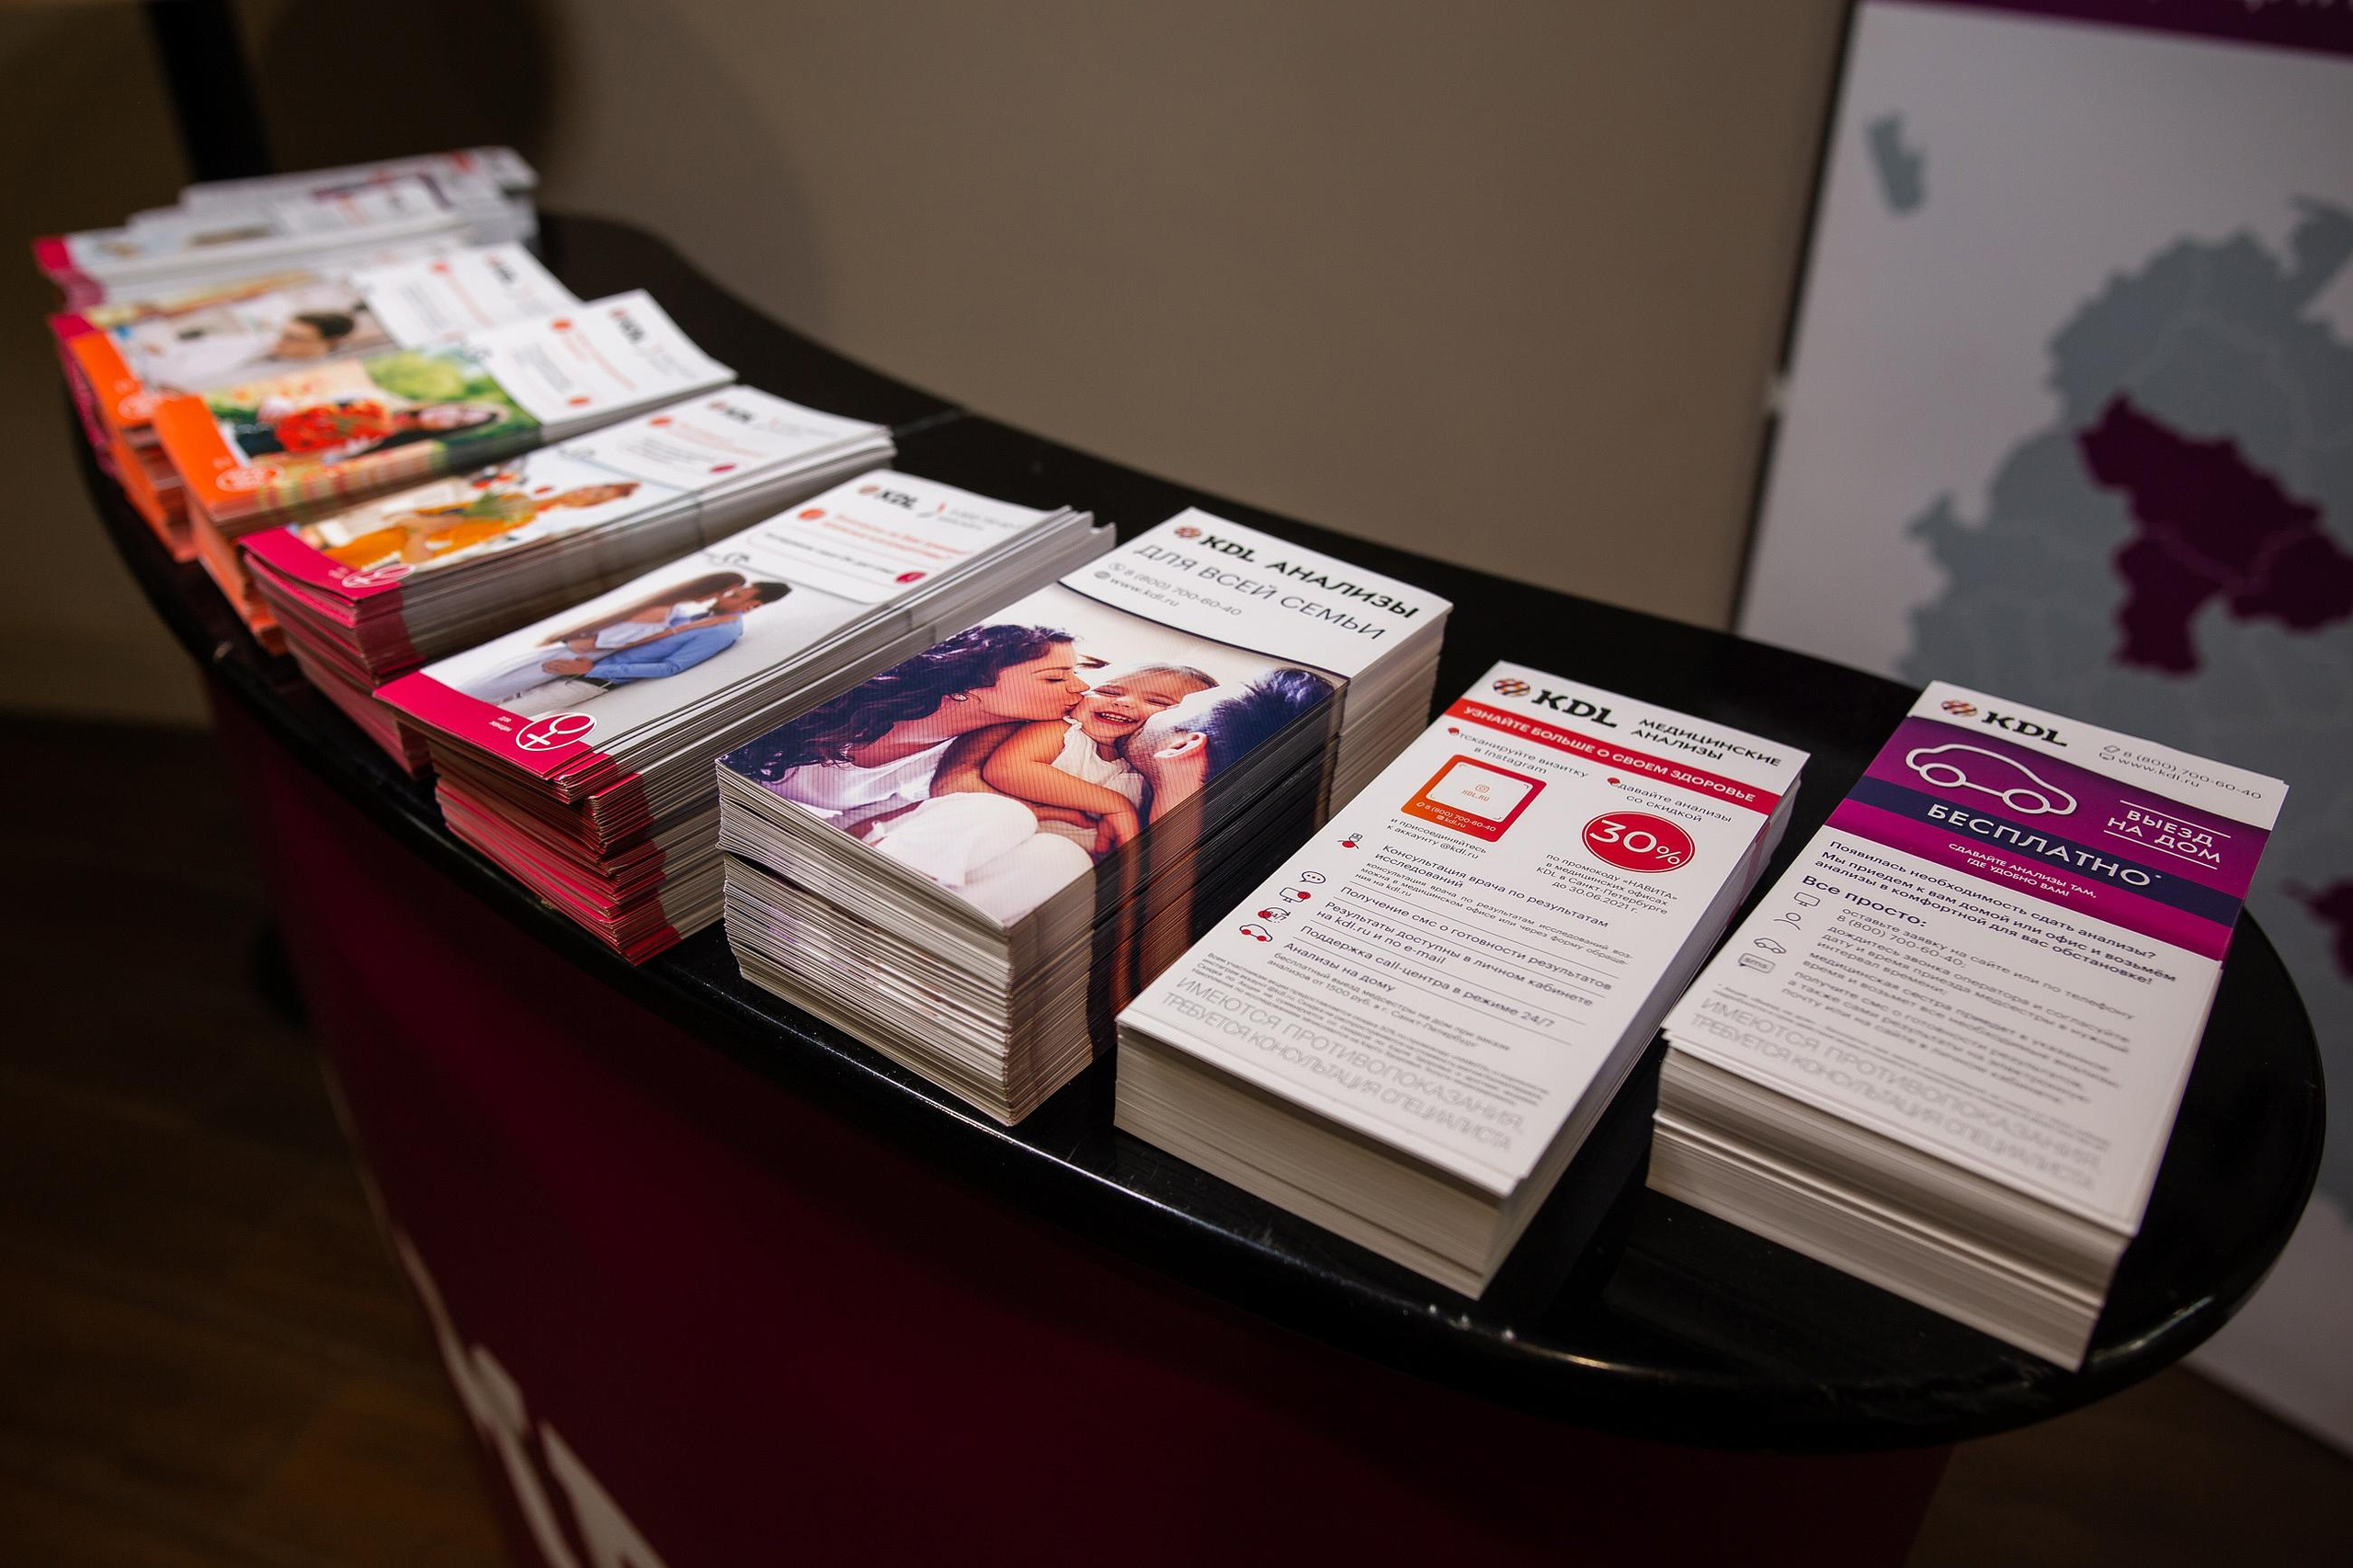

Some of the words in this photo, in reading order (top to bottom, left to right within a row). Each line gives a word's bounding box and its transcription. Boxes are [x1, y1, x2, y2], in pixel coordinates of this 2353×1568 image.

[1109, 578, 1180, 608] www.kdl.ru
[1132, 544, 1199, 572] ДЛЯ
[1197, 566, 1278, 600] ВСЕЙ
[1279, 596, 1386, 640] СЕМЬИ
[1133, 574, 1172, 591] (800)
[1172, 586, 1243, 616] 700-60-40
[1199, 535, 1255, 562] KDL
[1266, 562, 1419, 619] АНАЛИЗЫ
[1530, 688, 1618, 729] KDL
[1981, 710, 2068, 747] KDL
[1463, 706, 1530, 733] УЗНАЙТЕ
[1530, 727, 1596, 754] БОЛЬШЕ
[1597, 748, 1610, 757] О
[1612, 753, 1668, 775] СВОЕМ
[1670, 770, 1756, 802] ЗДОРОВЬЕ
[1483, 749, 1547, 775] Instagram
[1631, 729, 1723, 760] АНАЛИЗЫ
[1639, 719, 1781, 767] МЕДИЦИНСКИЕ
[1538, 758, 1589, 778] визитку
[2118, 758, 2200, 788] www.kdl.ru
[2136, 755, 2177, 775] (800)
[2182, 768, 2262, 800] 700-60-40
[1461, 790, 1491, 802] KDL.RU
[1626, 795, 1643, 803] со
[1646, 801, 1702, 823] скидкой
[1674, 801, 1732, 823] анализы
[1399, 821, 1486, 854] присоединяйтесь
[1430, 806, 1454, 818] (800)
[1454, 813, 1496, 832] 700-60-40
[1444, 817, 1466, 828] kdl.ru
[2107, 817, 2143, 837] НА
[2154, 834, 2221, 863] ДОМ
[2126, 810, 2213, 848] ВЫЕЗД
[1394, 827, 1439, 846] аккаунту
[1439, 842, 1479, 859] @kdl.ru
[1585, 816, 1692, 869] 30%
[1374, 853, 1463, 889] исследований
[1382, 845, 1467, 879] Консультация
[1468, 876, 1506, 892] врача
[1507, 890, 1525, 899] по
[1526, 896, 1608, 927] результатам
[1536, 866, 1556, 878] KDL
[1568, 877, 1668, 915] Санкт-Петербурге
[1546, 854, 1561, 862] по
[1562, 858, 1621, 882] промокоду
[1622, 880, 1677, 900] «НАВИТА»
[1553, 865, 1626, 892] медицинских
[1627, 889, 1668, 906] офисах
[1949, 843, 2007, 867] СДАВАЙТЕ
[2008, 864, 2067, 887] АНАЛИЗЫ
[2071, 883, 2097, 899] ТАМ,
[1966, 858, 1987, 869] ГДЕ
[1990, 865, 2038, 886] УДОБНО
[2040, 882, 2070, 897] ВАМ!
[1366, 862, 1427, 887] консультация
[1429, 885, 1457, 898] врача
[1475, 902, 1535, 926] результатам
[1400, 882, 1463, 908] медицинском
[1465, 905, 1496, 920] офисе
[1498, 917, 1517, 926] или
[1552, 881, 1567, 890] до
[1568, 886, 1630, 910] 30.06.2021
[1802, 875, 1841, 895] Все
[1845, 892, 1927, 927] просто:
[1821, 851, 1847, 865] Мы
[1848, 862, 1914, 889] приедем
[1927, 891, 1957, 904] вам
[1958, 902, 2010, 924] домой
[2013, 920, 2042, 935] или
[2045, 932, 2087, 950] офис
[2090, 948, 2102, 956] и
[2104, 952, 2177, 982] возьмём
[1829, 841, 1906, 873] Появилась
[1909, 869, 2028, 915] необходимость
[2030, 913, 2075, 932] сдать
[2077, 929, 2156, 960] анализы?
[1316, 911, 1333, 921] на
[1334, 916, 1371, 936] kdl.ru
[1383, 937, 1402, 948] по
[1404, 945, 1447, 964] e-mail
[1340, 886, 1410, 916] Получение
[1411, 915, 1438, 927] смс
[1450, 928, 1527, 960] готовности
[1527, 957, 1612, 991] результатов
[1814, 860, 1877, 886] анализы
[1891, 888, 1987, 926] комфортной
[1988, 923, 2018, 937] для
[2021, 934, 2049, 948] вас
[2052, 946, 2153, 985] обстановке!
[1836, 915, 1847, 923] 8
[1848, 919, 1886, 938] (800)
[1889, 933, 1967, 969] 700-60-40;
[1283, 942, 1340, 970] Анализы
[1341, 967, 1358, 978] на
[1358, 974, 1395, 993] дому
[1324, 901, 1395, 934] Результаты
[1395, 930, 1461, 959] доступны
[1472, 960, 1526, 983] личном
[1527, 980, 1593, 1006] кабинете
[1816, 941, 1881, 969] интервал
[1821, 934, 1854, 949] дату
[1867, 950, 1910, 970] время
[1827, 926, 1901, 957] дождитесь
[1903, 954, 1951, 976] звонка
[1953, 973, 2030, 1006] оператора
[1842, 908, 1901, 933] оставьте
[1903, 930, 1949, 951] заявку
[1949, 949, 1968, 959] на
[1970, 956, 2011, 974] сайте
[2013, 971, 2040, 985] или
[1300, 926, 1373, 960] Поддержка
[1375, 957, 1450, 990] call-центра
[1462, 991, 1519, 1016] режиме
[1520, 1011, 1555, 1027] 24/7
[1325, 983, 1350, 997] 1500
[1162, 991, 1252, 1040] ТРЕБУЕТСЯ
[1176, 977, 1282, 1030] ИМЕЮТСЯ
